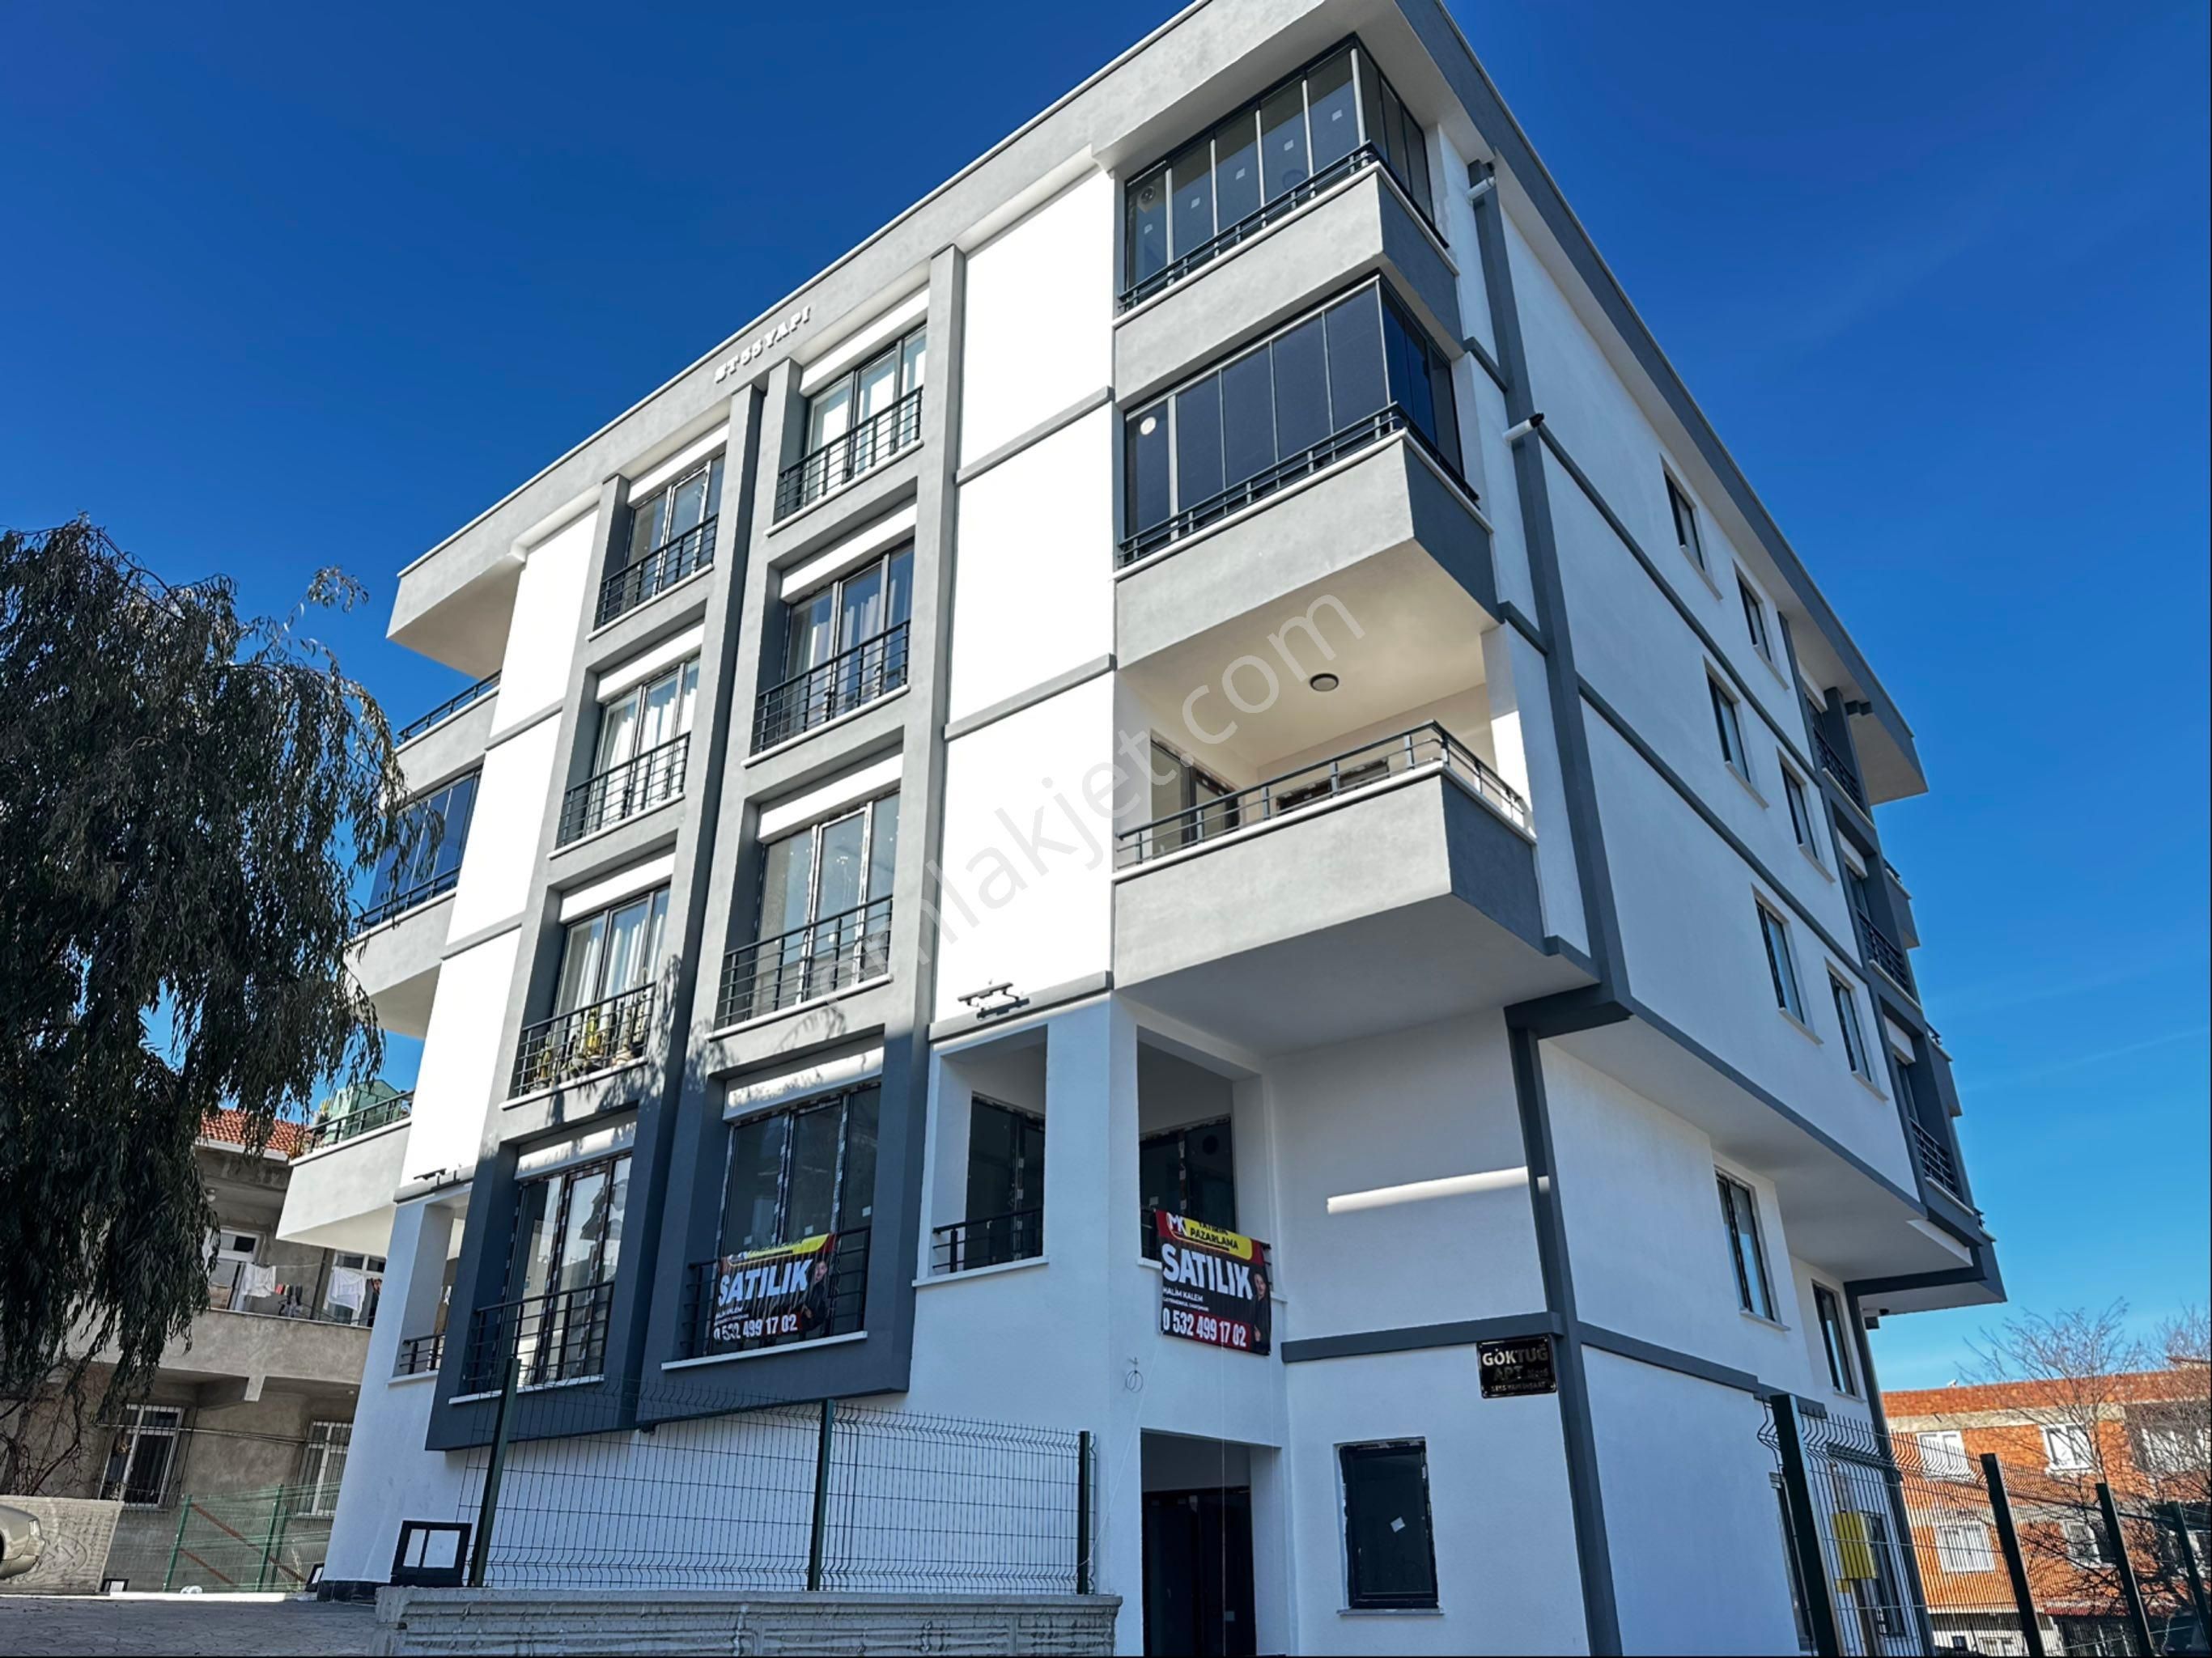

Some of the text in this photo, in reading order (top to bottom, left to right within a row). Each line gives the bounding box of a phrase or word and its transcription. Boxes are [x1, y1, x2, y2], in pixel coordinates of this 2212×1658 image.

[764, 304, 811, 348] YAPI
[1190, 1228, 1238, 1249] PAZARLAMA
[718, 1258, 813, 1307] SATILIK
[1161, 1243, 1254, 1300] SATILIK
[1182, 1291, 1204, 1302] KALEM
[743, 1318, 763, 1338] 499
[766, 1317, 778, 1335] 17
[781, 1313, 798, 1333] 02
[1163, 1307, 1246, 1347] 0 532 499 17 02
[1482, 1342, 1549, 1366] GÖKTUĞ
